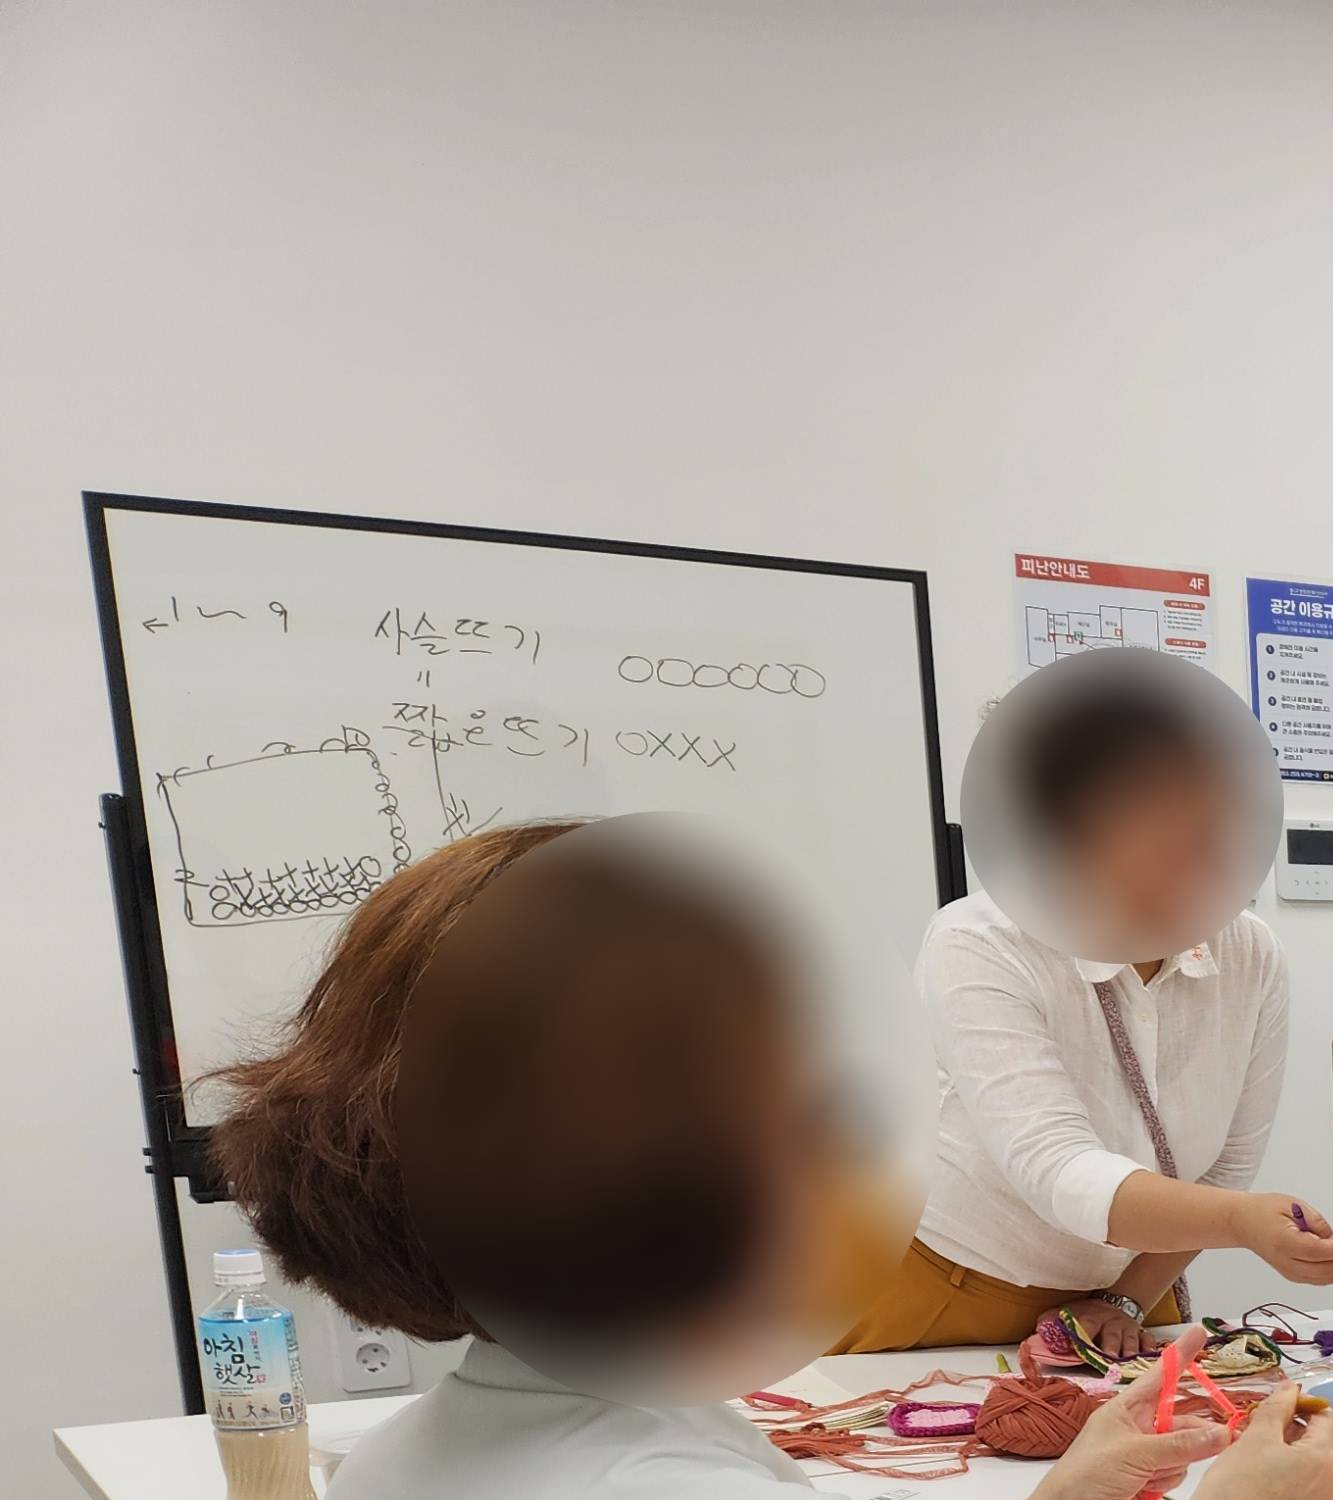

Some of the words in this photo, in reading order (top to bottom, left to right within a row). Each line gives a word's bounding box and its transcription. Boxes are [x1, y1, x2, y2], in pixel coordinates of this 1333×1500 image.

[1021, 558, 1091, 580] 피난안내도
[1189, 577, 1205, 591] 4F
[1269, 598, 1297, 616] 공간
[203, 1333, 246, 1365] 아침
[213, 1362, 261, 1386] 햇살
